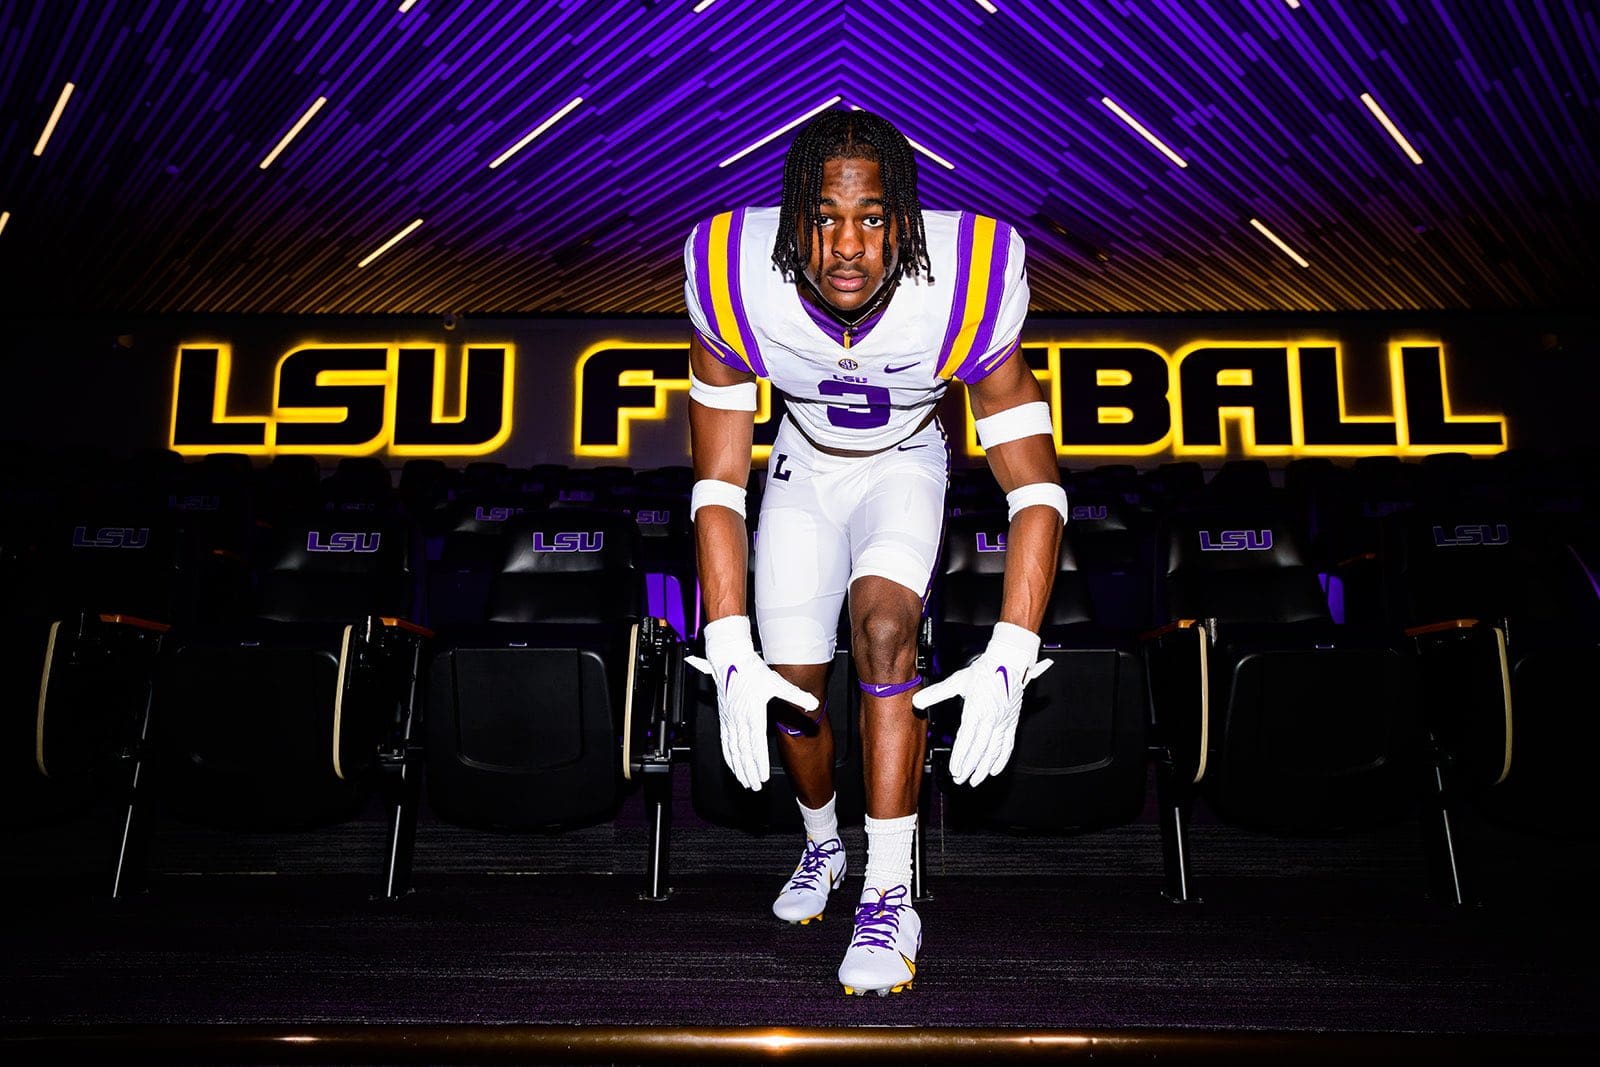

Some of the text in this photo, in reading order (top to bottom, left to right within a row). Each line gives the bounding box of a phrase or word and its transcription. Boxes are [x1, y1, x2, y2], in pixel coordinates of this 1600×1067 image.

[832, 374, 868, 384] LSU
[171, 341, 1507, 455] LSU FBALL
[817, 380, 891, 430] 3
[773, 453, 792, 482] L
[73, 526, 149, 549] LSU
[307, 531, 381, 553] LSU
[532, 531, 604, 553] LSU
[1199, 529, 1274, 551] LSU
[1432, 524, 1511, 547] LSU
